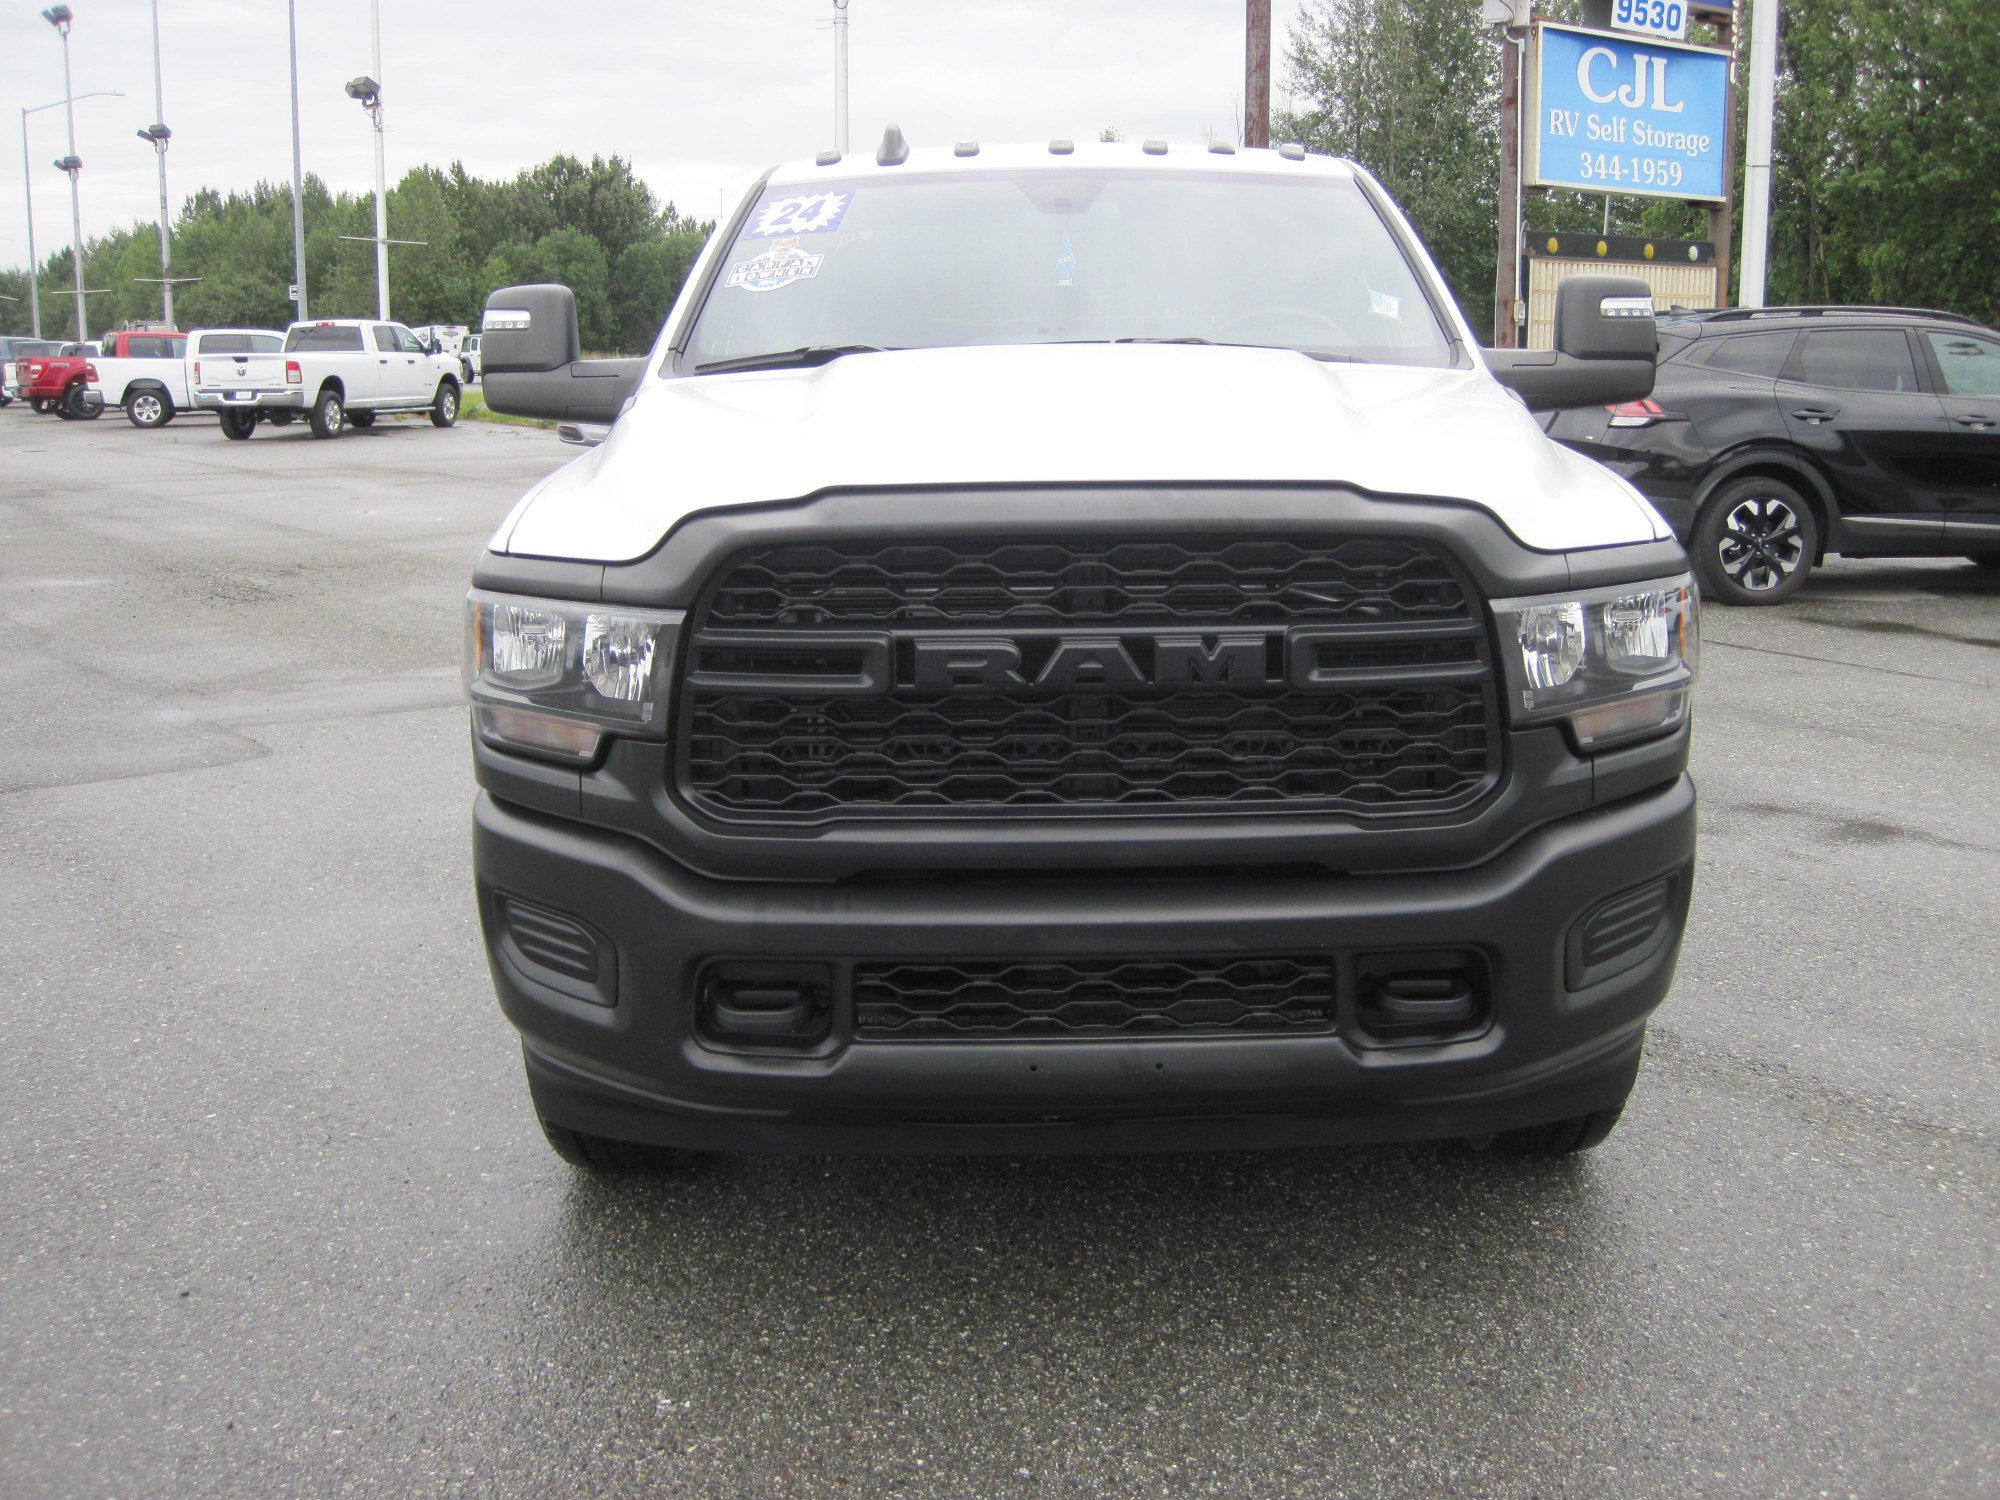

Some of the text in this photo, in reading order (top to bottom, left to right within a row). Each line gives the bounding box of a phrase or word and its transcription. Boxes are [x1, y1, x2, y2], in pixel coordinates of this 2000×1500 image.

[1616, 0, 1681, 31] 9530
[1577, 46, 1684, 112] CJL
[1549, 108, 1710, 157] RV Self Storage
[1580, 151, 1683, 187] 344-1959
[769, 199, 827, 226] 24
[736, 257, 816, 274] CARFAX
[914, 634, 1267, 686] RAM
